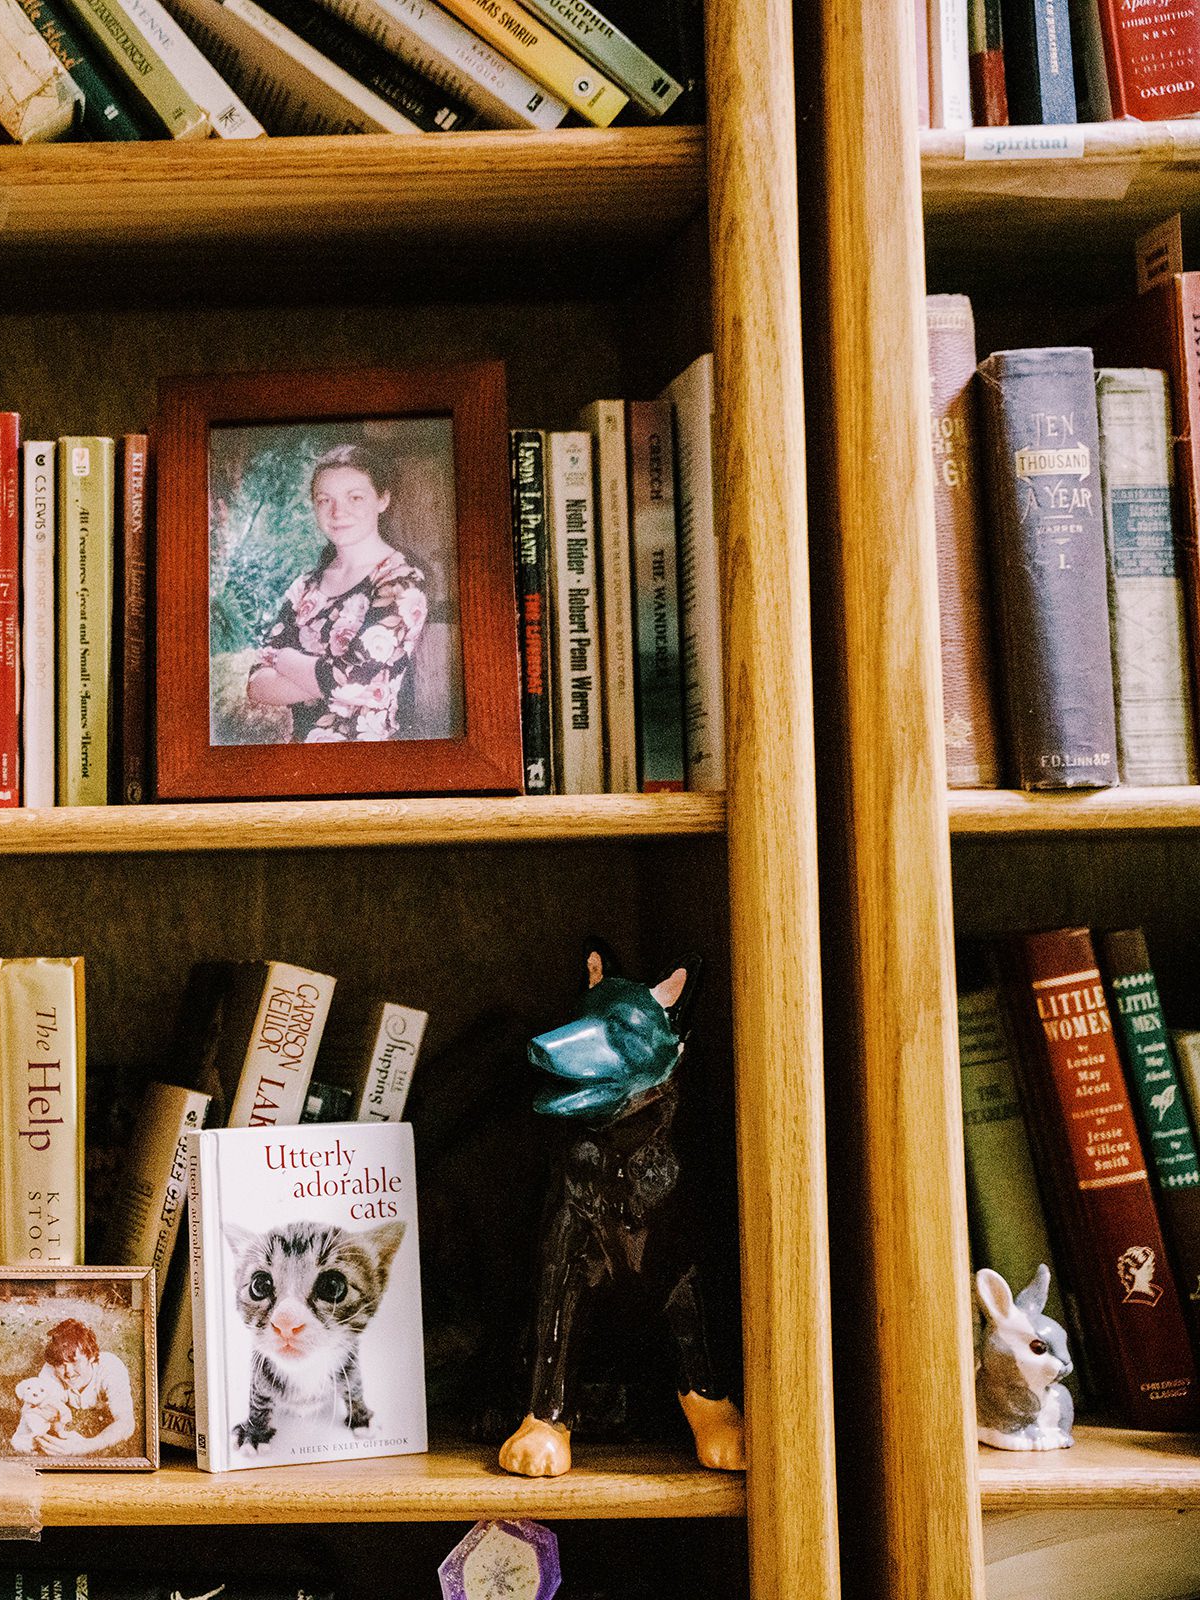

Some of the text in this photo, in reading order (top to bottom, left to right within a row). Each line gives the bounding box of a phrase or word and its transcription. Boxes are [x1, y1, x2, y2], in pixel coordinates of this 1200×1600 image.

[497, 11, 539, 51] SWARUP
[1140, 80, 1195, 98] OXFORD
[983, 136, 1069, 153] Spiritual
[1028, 411, 1075, 448] TEN
[1019, 453, 1088, 471] THOUSAND
[131, 452, 143, 534] KIT PEARSON
[1019, 479, 1094, 524] A YEAR
[79, 528, 90, 585] Creatures
[0, 582, 10, 598] 7
[77, 587, 91, 621] Great
[563, 497, 592, 731] Night Rider Robert Penn Warren
[5, 614, 15, 668] THE LAST
[79, 623, 91, 645] and
[653, 586, 669, 679] WANDERER
[79, 648, 92, 682] Small
[78, 689, 92, 729] James
[79, 730, 92, 780] Herriot
[1036, 985, 1107, 1020] LITTLE
[1118, 989, 1160, 1015] LITTLE
[257, 988, 295, 1054] KEILLOR
[278, 984, 321, 1070] GARRISON
[1042, 1010, 1111, 1043] WOMEN
[1131, 1012, 1163, 1034] MEN
[369, 1013, 417, 1106] Shipping
[1066, 1053, 1106, 1069] Louisa
[1077, 1070, 1102, 1083] May
[18, 1005, 64, 1153] The Help
[1075, 1082, 1111, 1098] Alcott
[1085, 1141, 1131, 1157] Willcox
[1086, 1128, 1123, 1144] Jessie
[264, 1139, 356, 1176] Utterly
[1094, 1156, 1130, 1172] Smith
[293, 1166, 403, 1200] adorable
[190, 1155, 201, 1298] Utterly adorable cats
[350, 1200, 398, 1221] cats
[299, 1444, 329, 1454] HELEN
